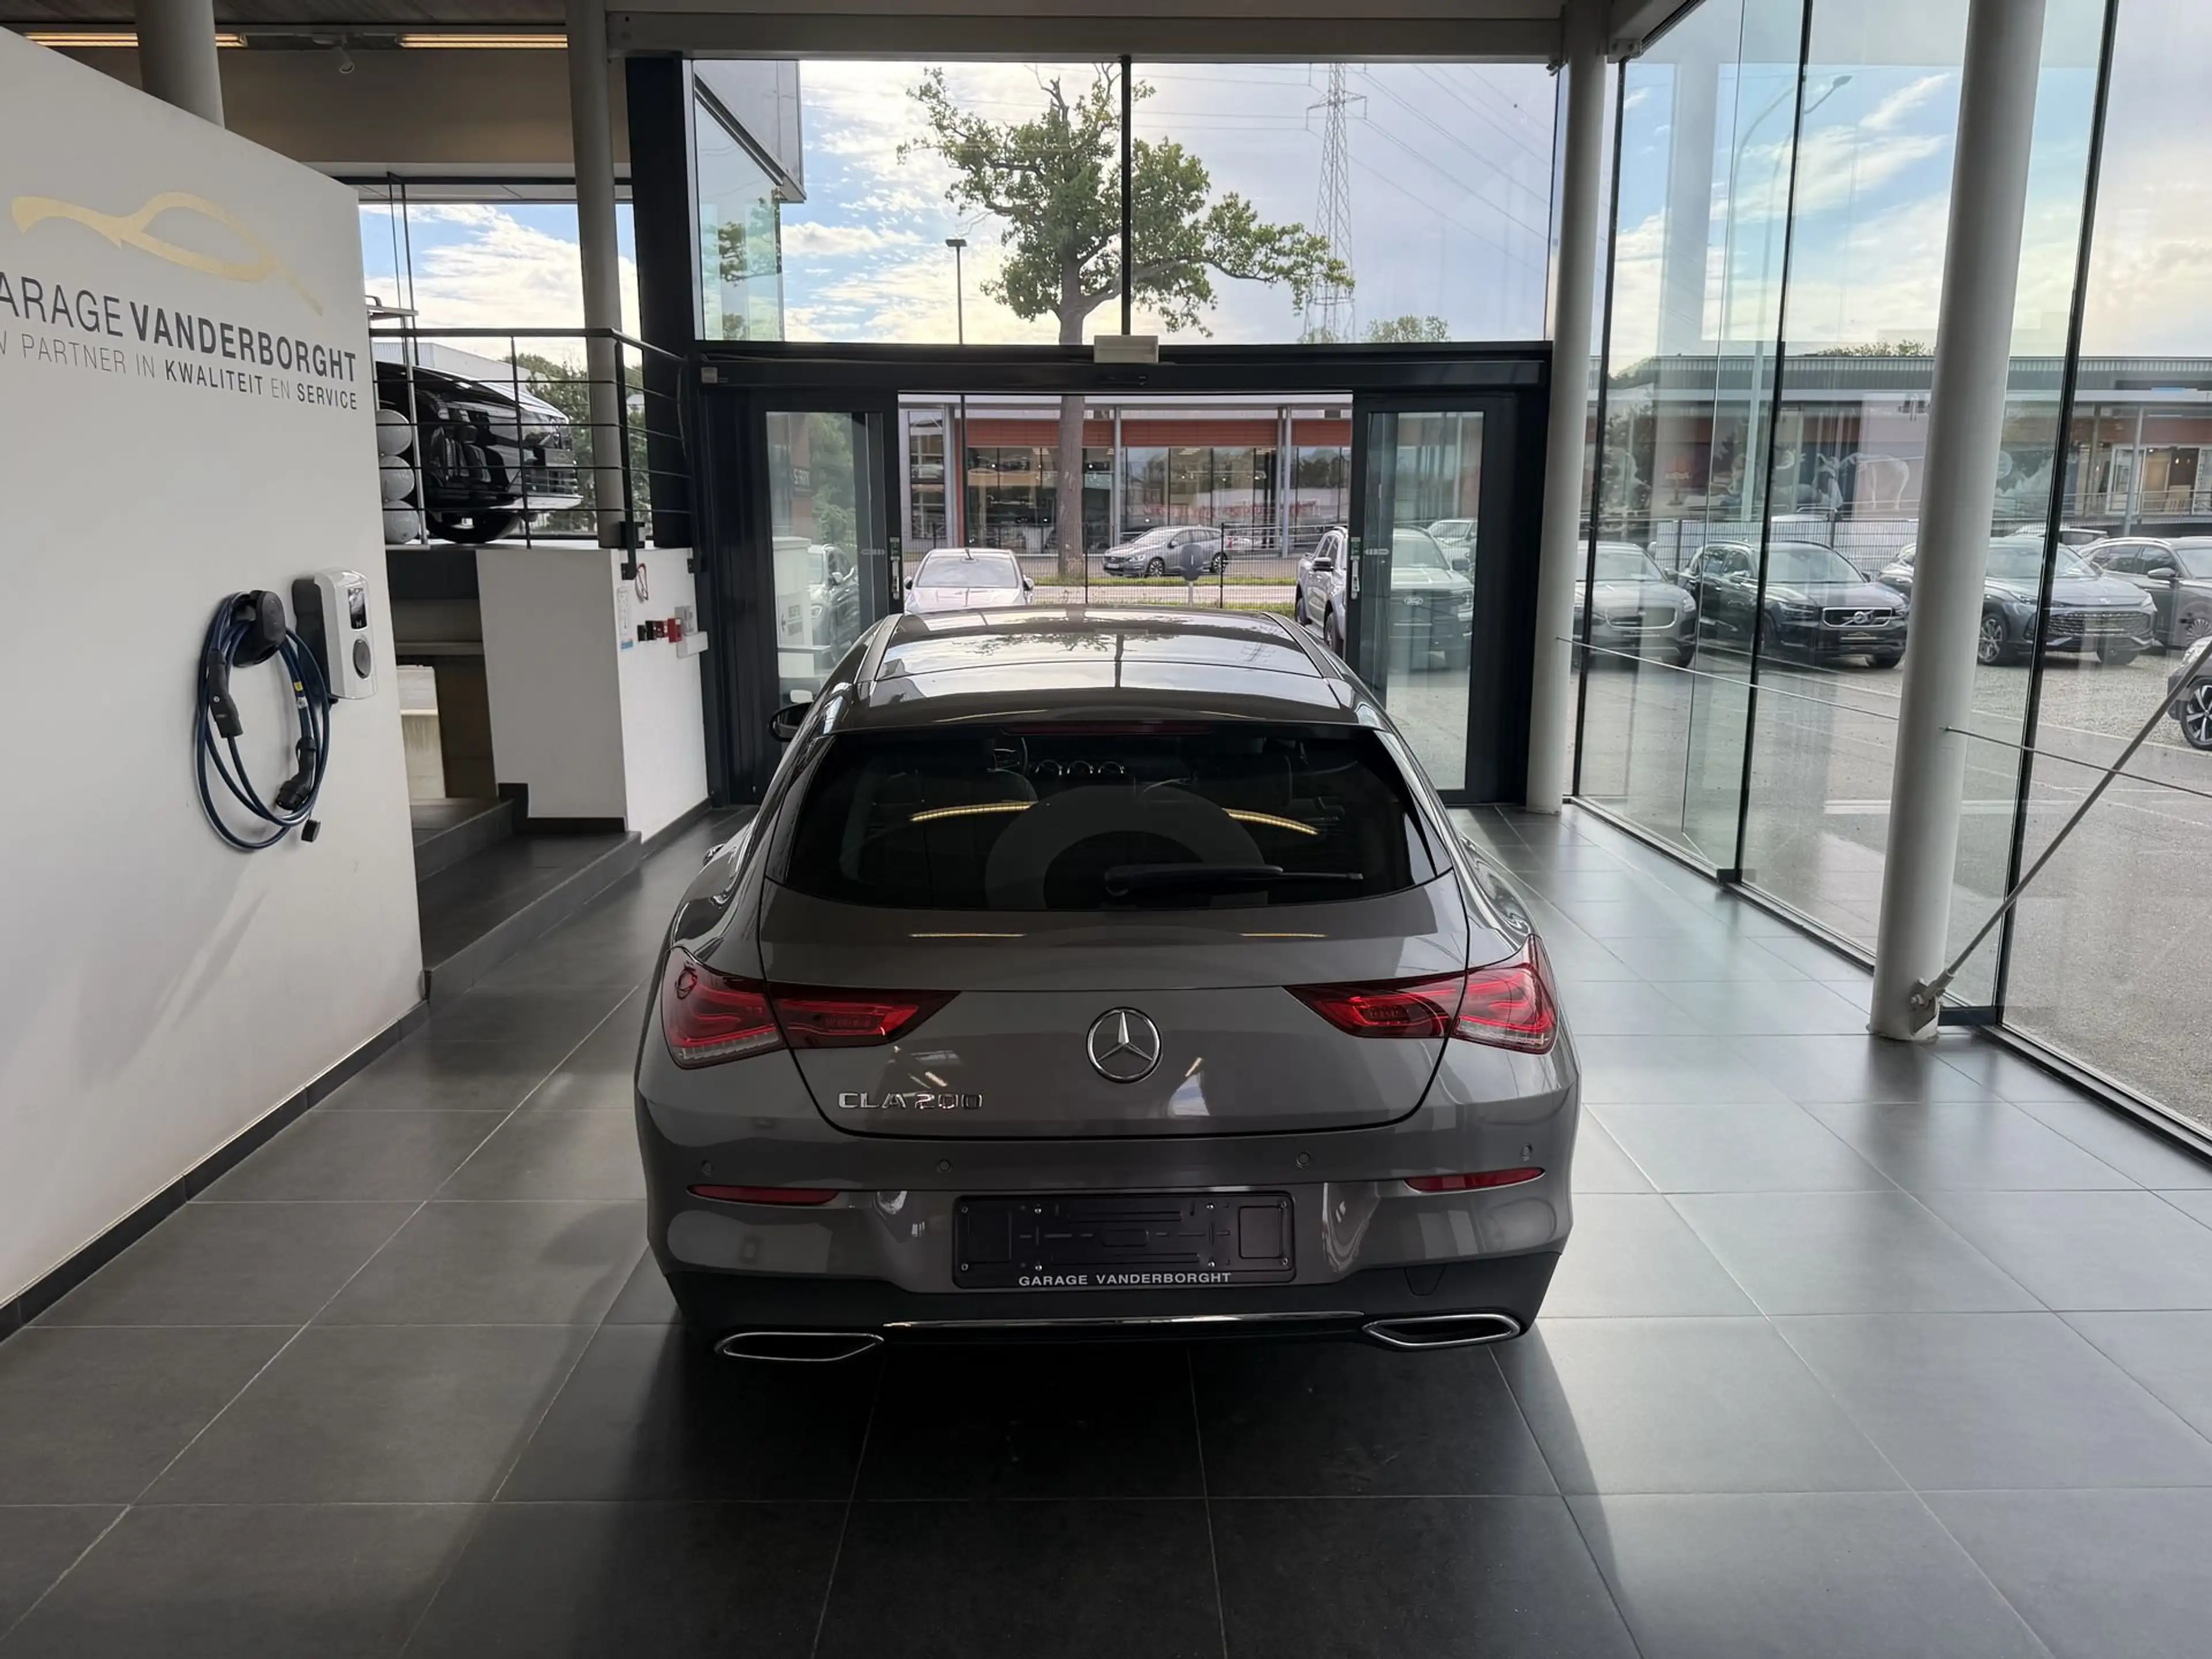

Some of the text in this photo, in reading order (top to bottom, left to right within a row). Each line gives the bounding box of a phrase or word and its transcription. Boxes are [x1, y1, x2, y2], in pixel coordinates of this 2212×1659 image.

[130, 301, 355, 382] VANDERBORGHT
[22, 334, 126, 374] PARTNER
[136, 353, 154, 378] IN
[165, 359, 263, 395] KWALITEIT
[271, 378, 290, 399] EN
[297, 382, 357, 410] SERVICE
[839, 1093, 983, 1109] CLA 200
[1018, 1272, 1232, 1286] GARAGE VANDERBORGHT
